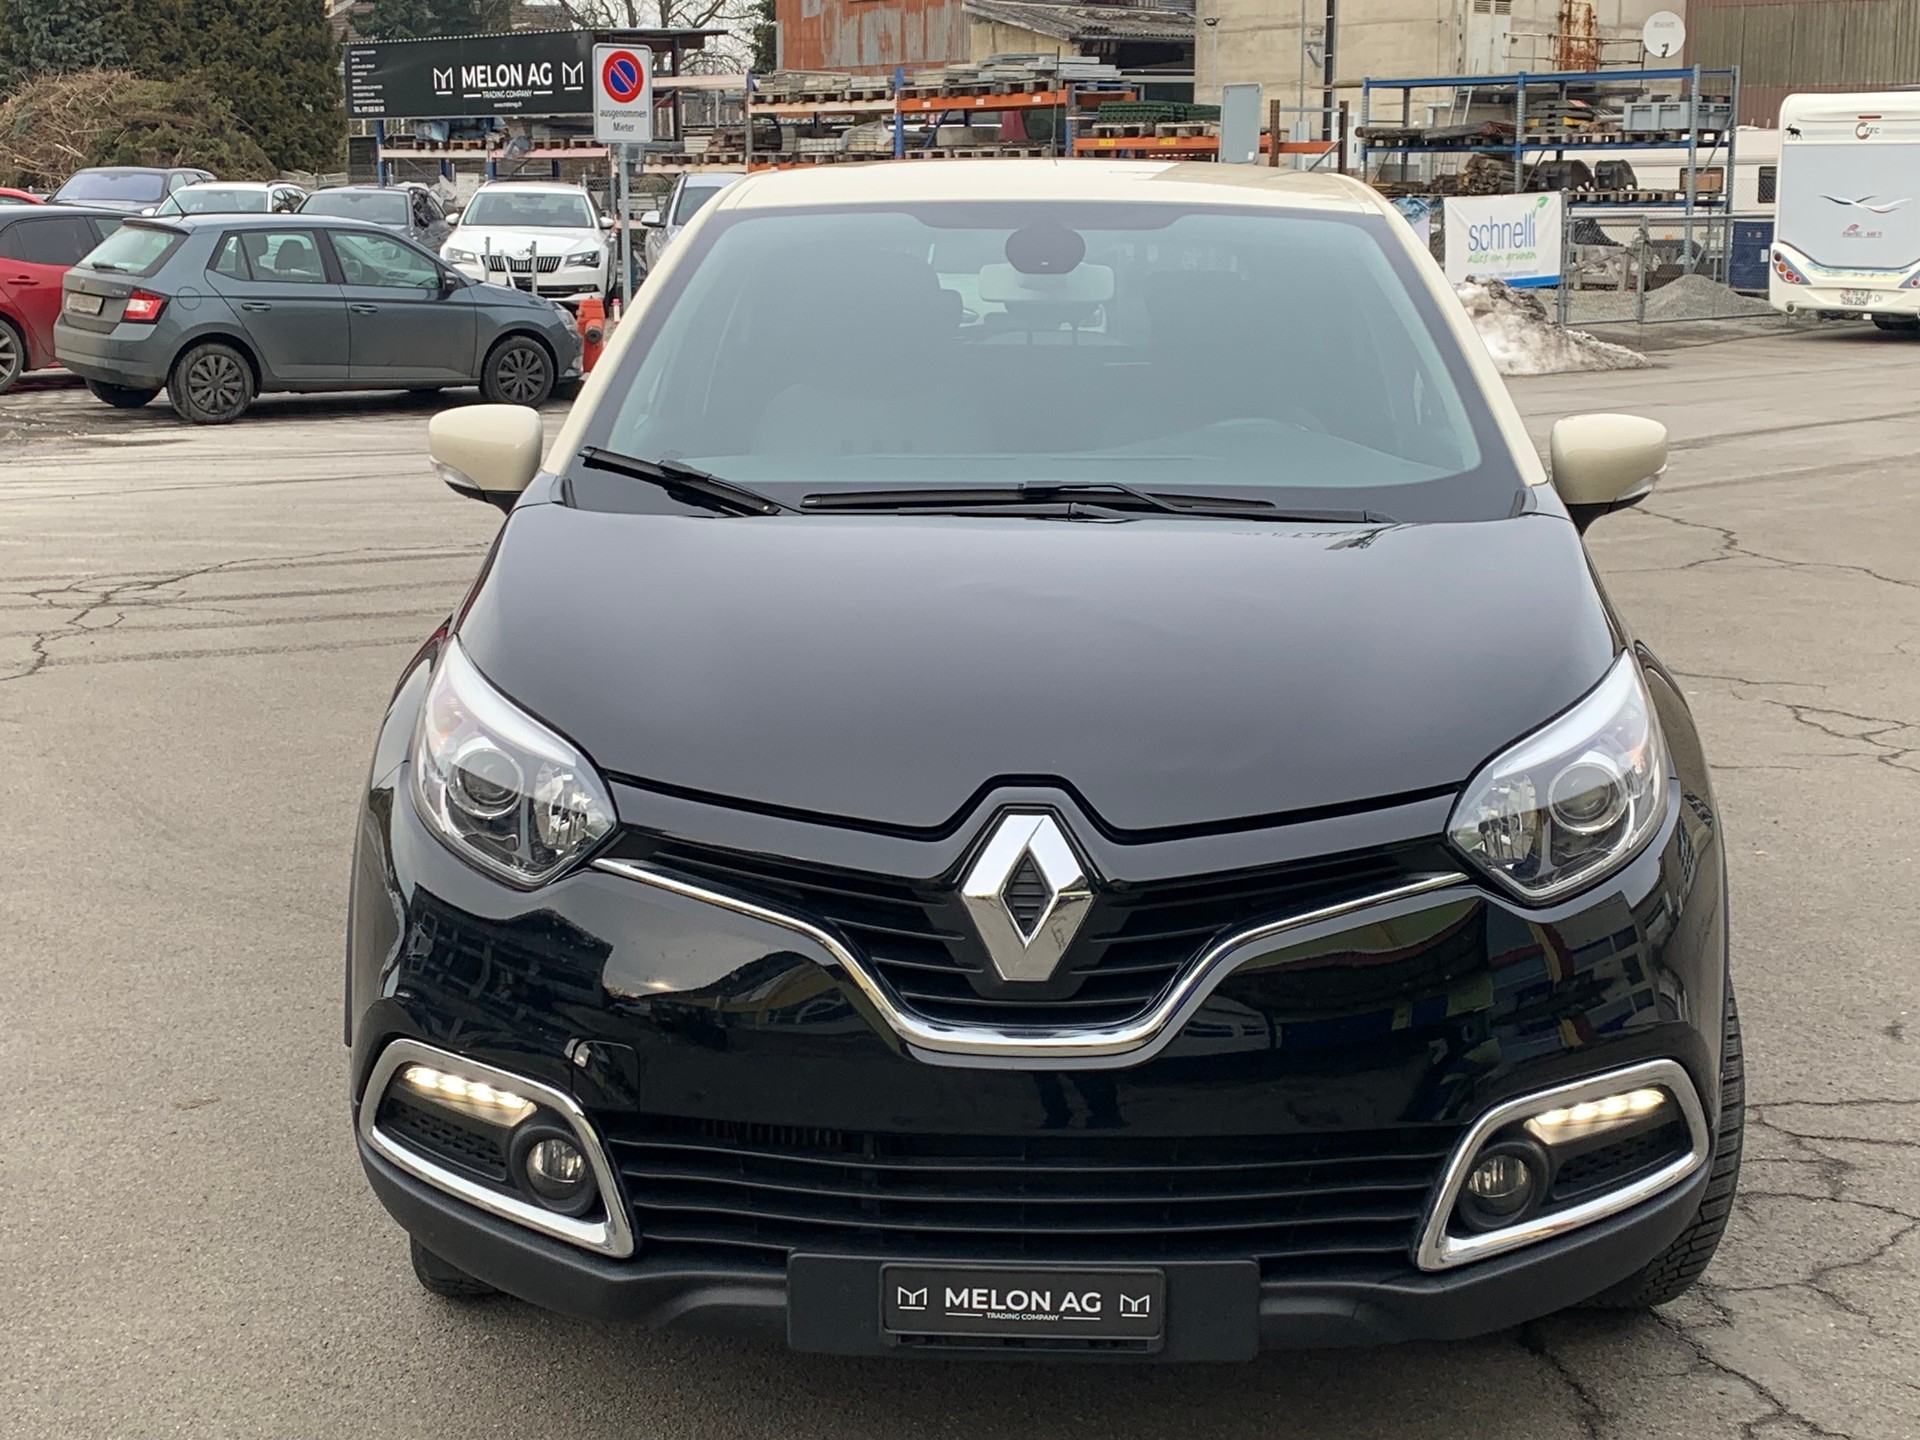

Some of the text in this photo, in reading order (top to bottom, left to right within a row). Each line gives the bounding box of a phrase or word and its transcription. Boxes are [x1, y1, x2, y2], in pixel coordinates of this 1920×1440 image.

[462, 64, 523, 88] MELON
[528, 62, 552, 86] AG
[482, 89, 532, 98] TRADING COMPANY
[600, 109, 647, 119] ausgenommen
[613, 122, 635, 132] Mieter
[1468, 213, 1537, 251] schnelli
[945, 1287, 1051, 1311] MELON
[1059, 1291, 1101, 1313] AG
[986, 1312, 1059, 1322] TRADING COMPANY
